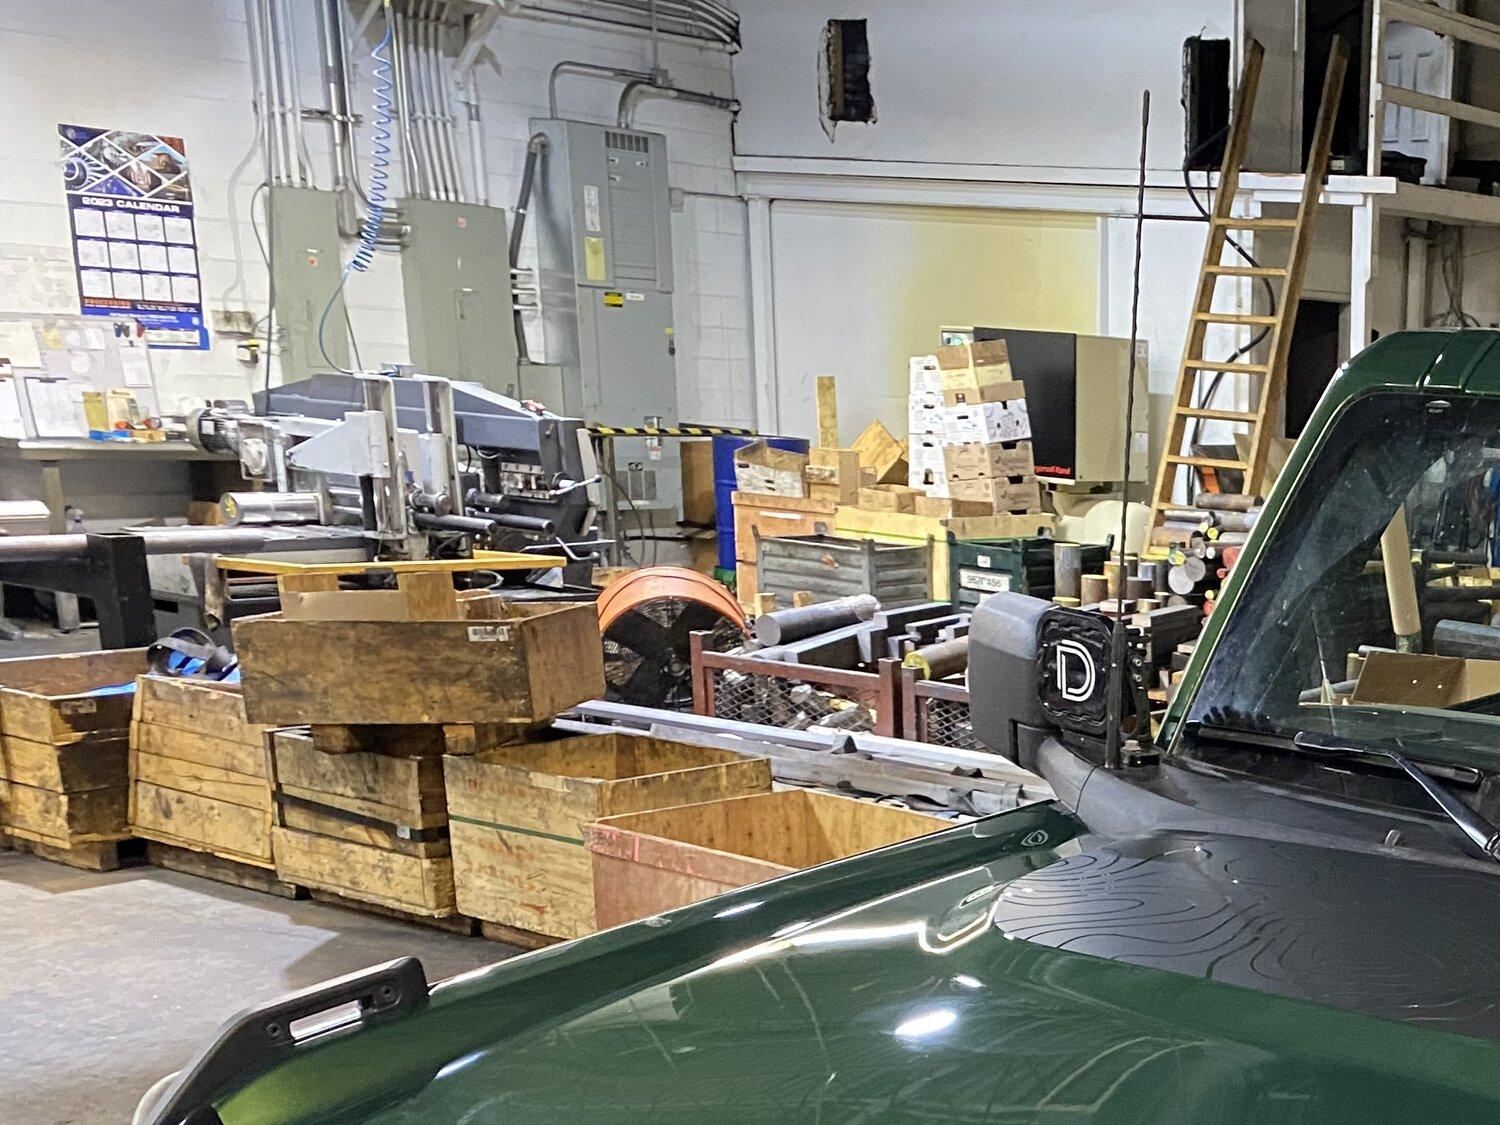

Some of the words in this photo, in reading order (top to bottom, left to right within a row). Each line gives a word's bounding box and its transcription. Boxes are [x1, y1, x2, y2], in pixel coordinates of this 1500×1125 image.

[81, 196, 113, 207] 2023
[116, 199, 180, 213] CALENDAR
[1056, 639, 1096, 702] D
